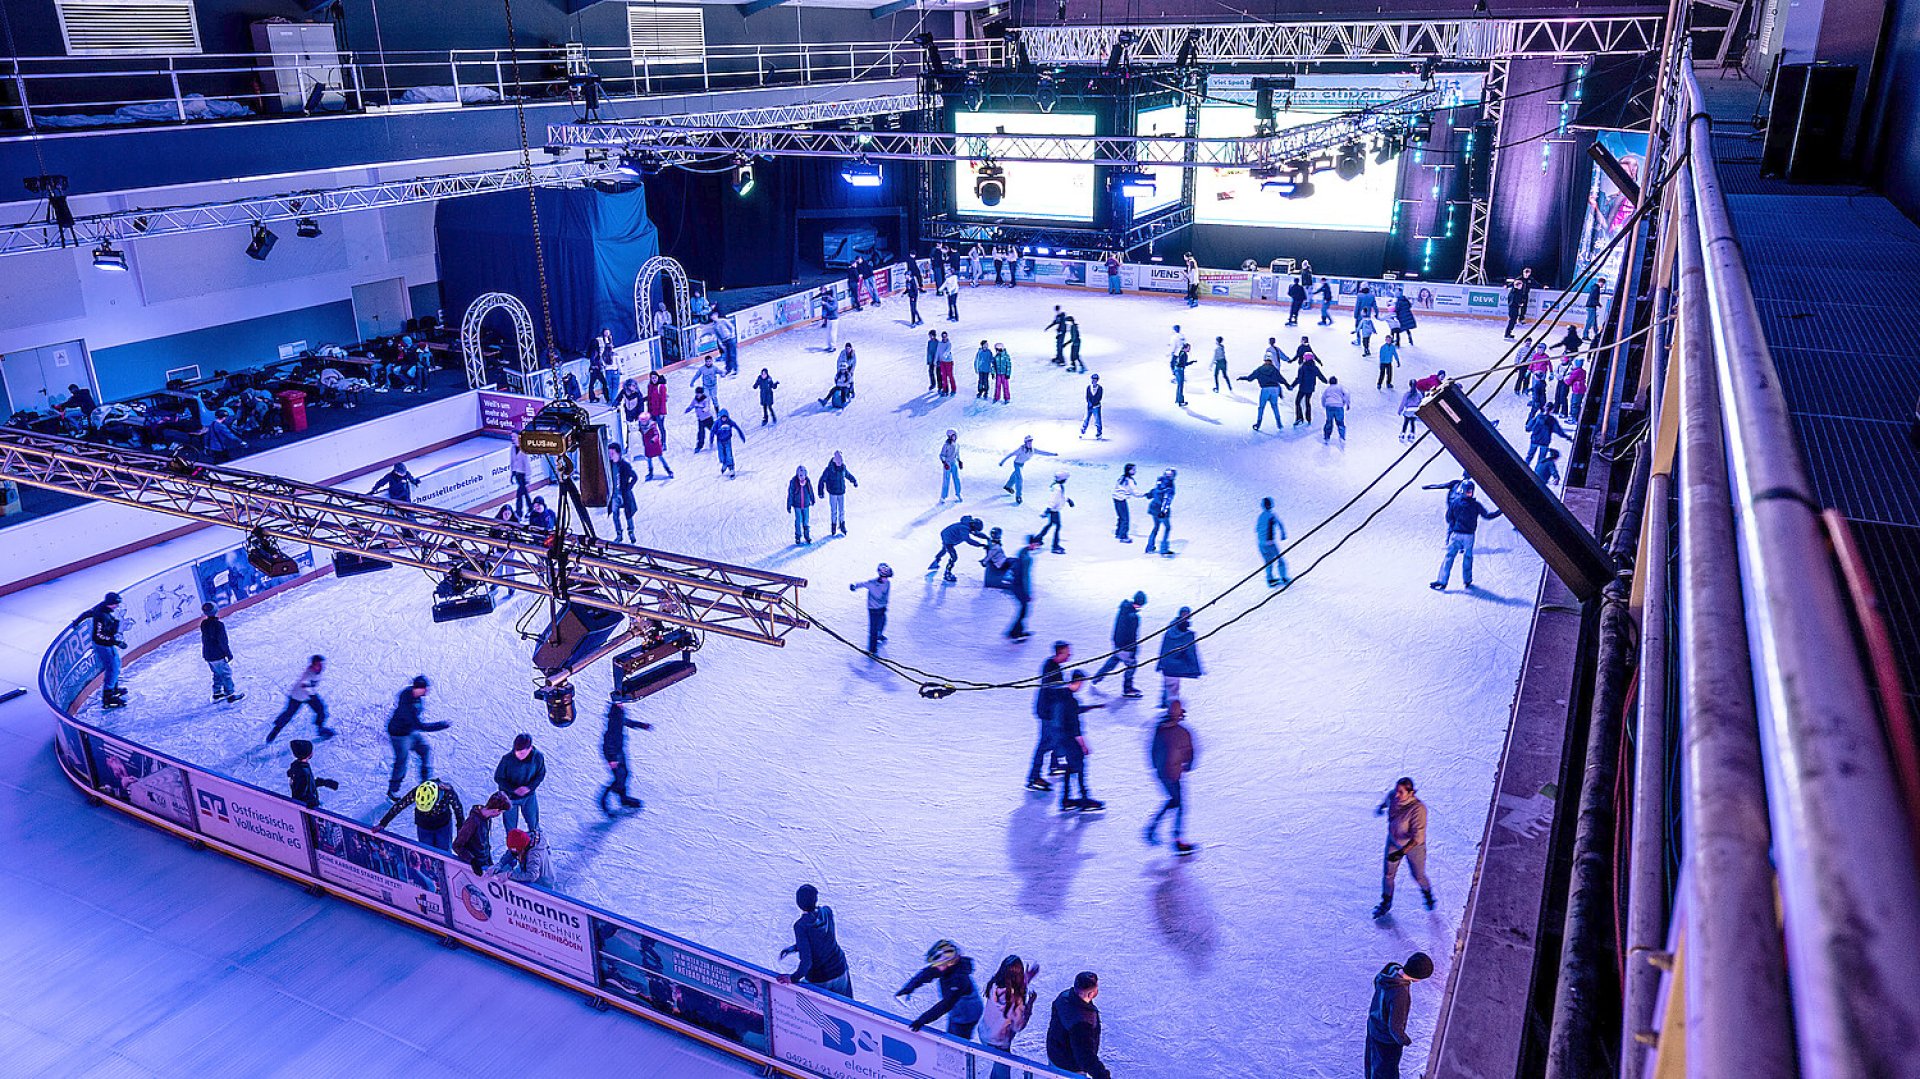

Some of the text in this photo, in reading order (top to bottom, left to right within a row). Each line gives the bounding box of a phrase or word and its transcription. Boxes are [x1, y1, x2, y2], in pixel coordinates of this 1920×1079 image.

[1151, 269, 1180, 279] IVENS
[412, 475, 484, 504] chaustellerbetrieb
[231, 802, 295, 833] Ostfriesische
[233, 815, 302, 849] Volksbank eG
[487, 881, 581, 929] Oltmanns
[506, 906, 582, 943] DÄMMTECHNIK
[515, 920, 584, 952] NATUR-STEINBÖDEN
